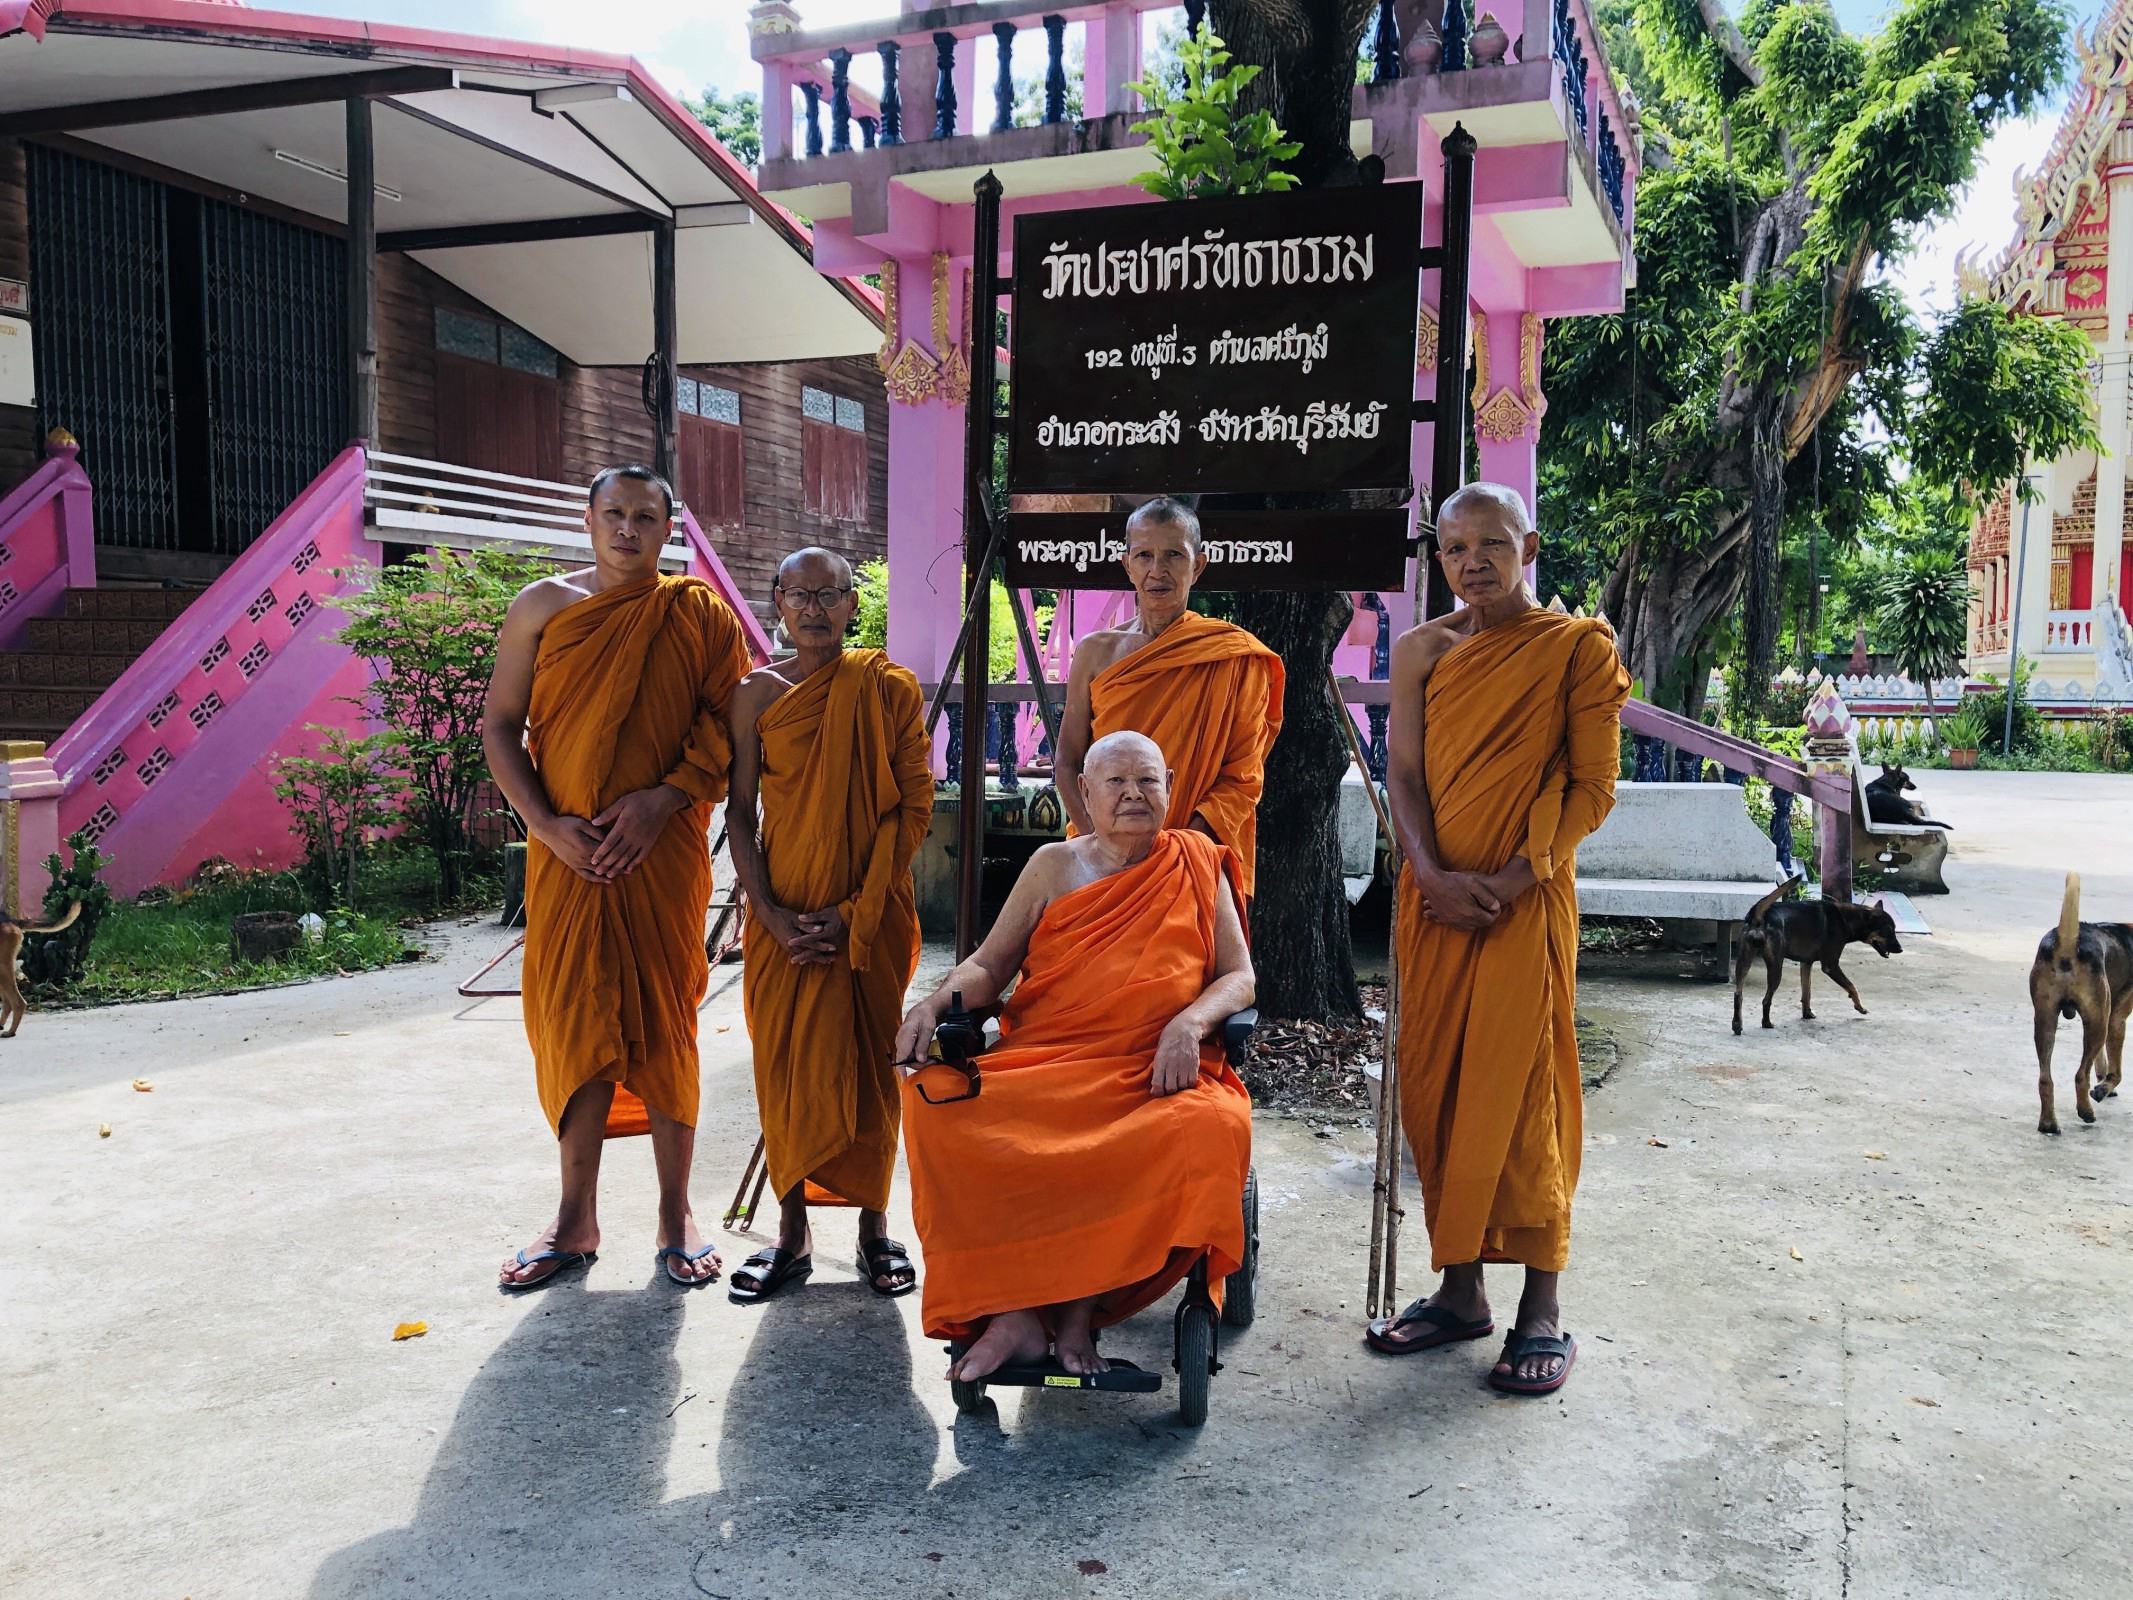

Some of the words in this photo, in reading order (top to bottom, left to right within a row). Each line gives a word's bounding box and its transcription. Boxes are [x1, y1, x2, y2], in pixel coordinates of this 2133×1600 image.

[1084, 348, 1124, 370] 192
[1037, 409, 1181, 447] อำเภอกระสัง
[1198, 399, 1389, 455] จังหวัดบุรีรัมย์
